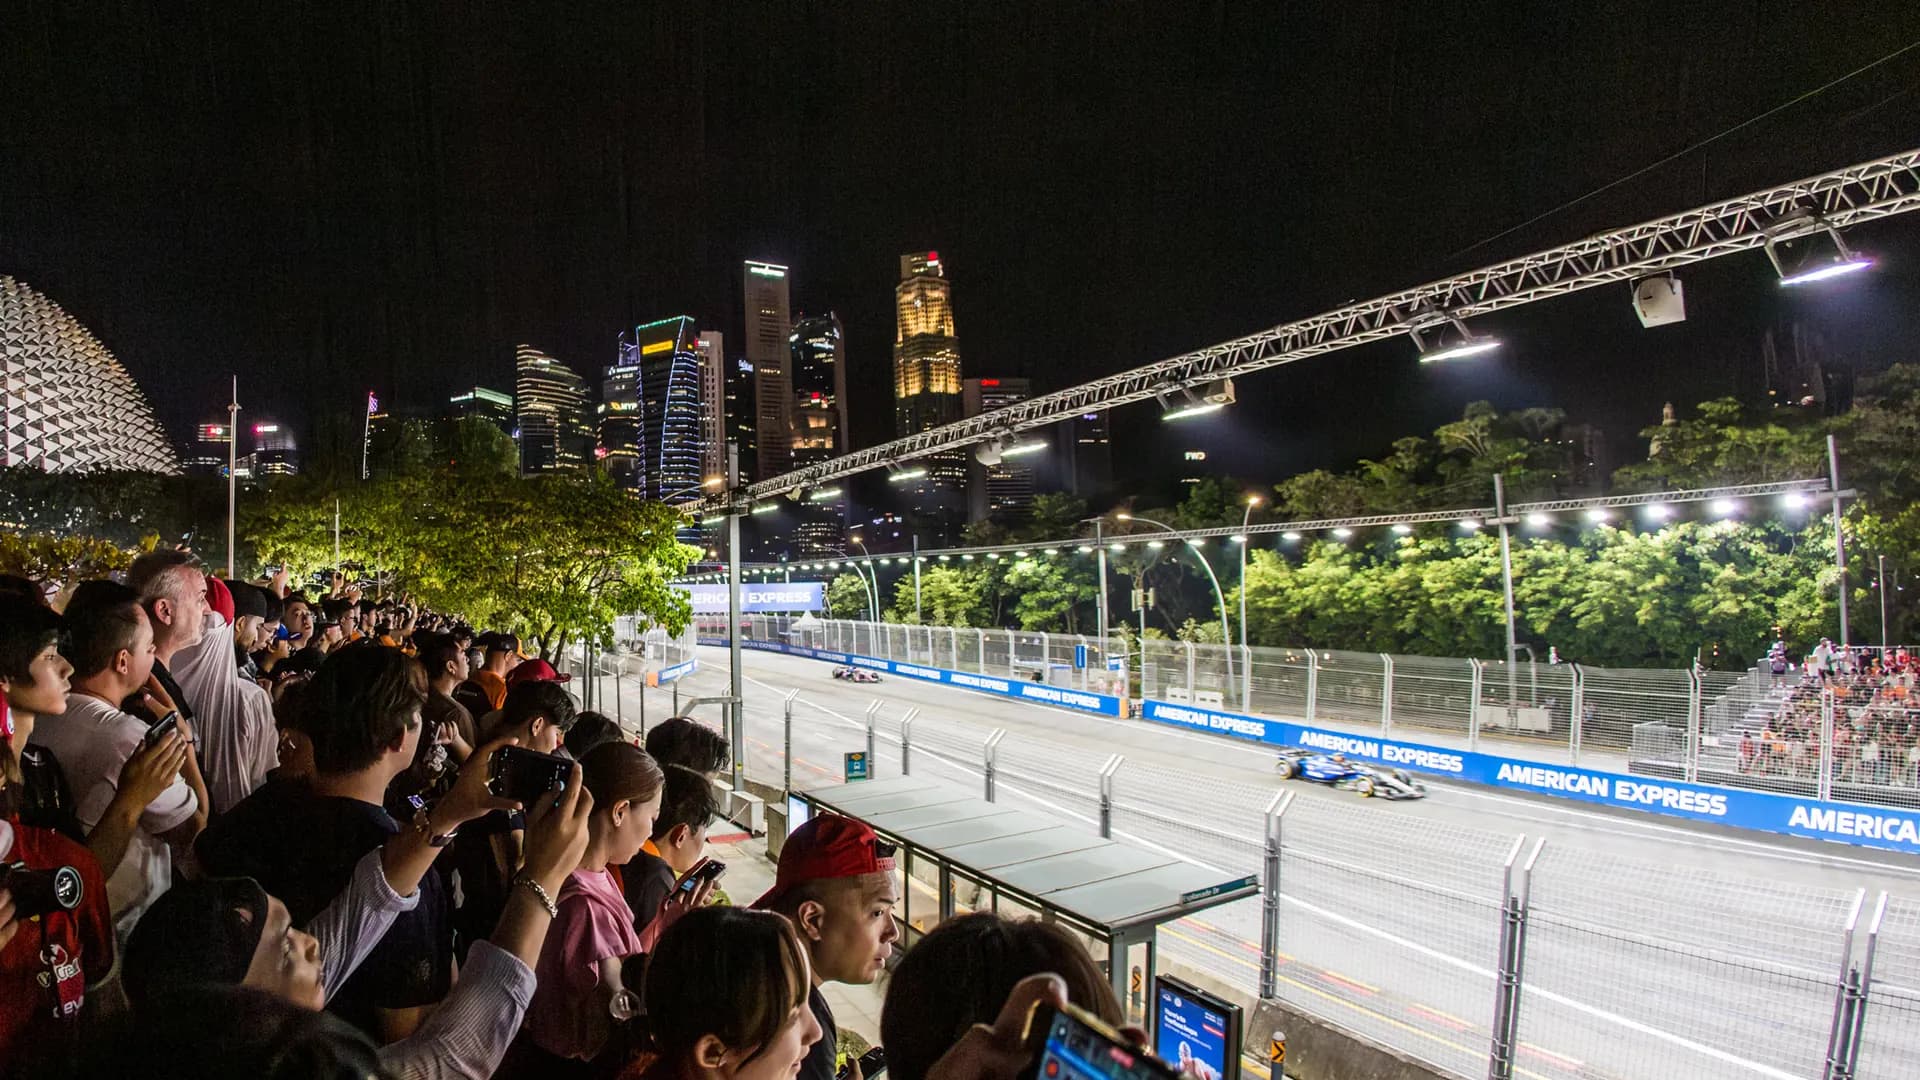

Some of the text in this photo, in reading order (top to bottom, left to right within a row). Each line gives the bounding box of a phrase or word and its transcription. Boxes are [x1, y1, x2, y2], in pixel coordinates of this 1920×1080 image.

[748, 591, 812, 604] EXPRESS
[950, 673, 1009, 692] AMERICAN EXPRESS
[1022, 685, 1100, 709] AMERICAN EXPRESS
[1154, 705, 1266, 737] AMERICAN EXPRESS
[1299, 730, 1463, 772] AMERICAN EXPRESS
[1497, 763, 1728, 816] AMERICAN EXPRESS
[1788, 805, 1920, 844] AMERICA
